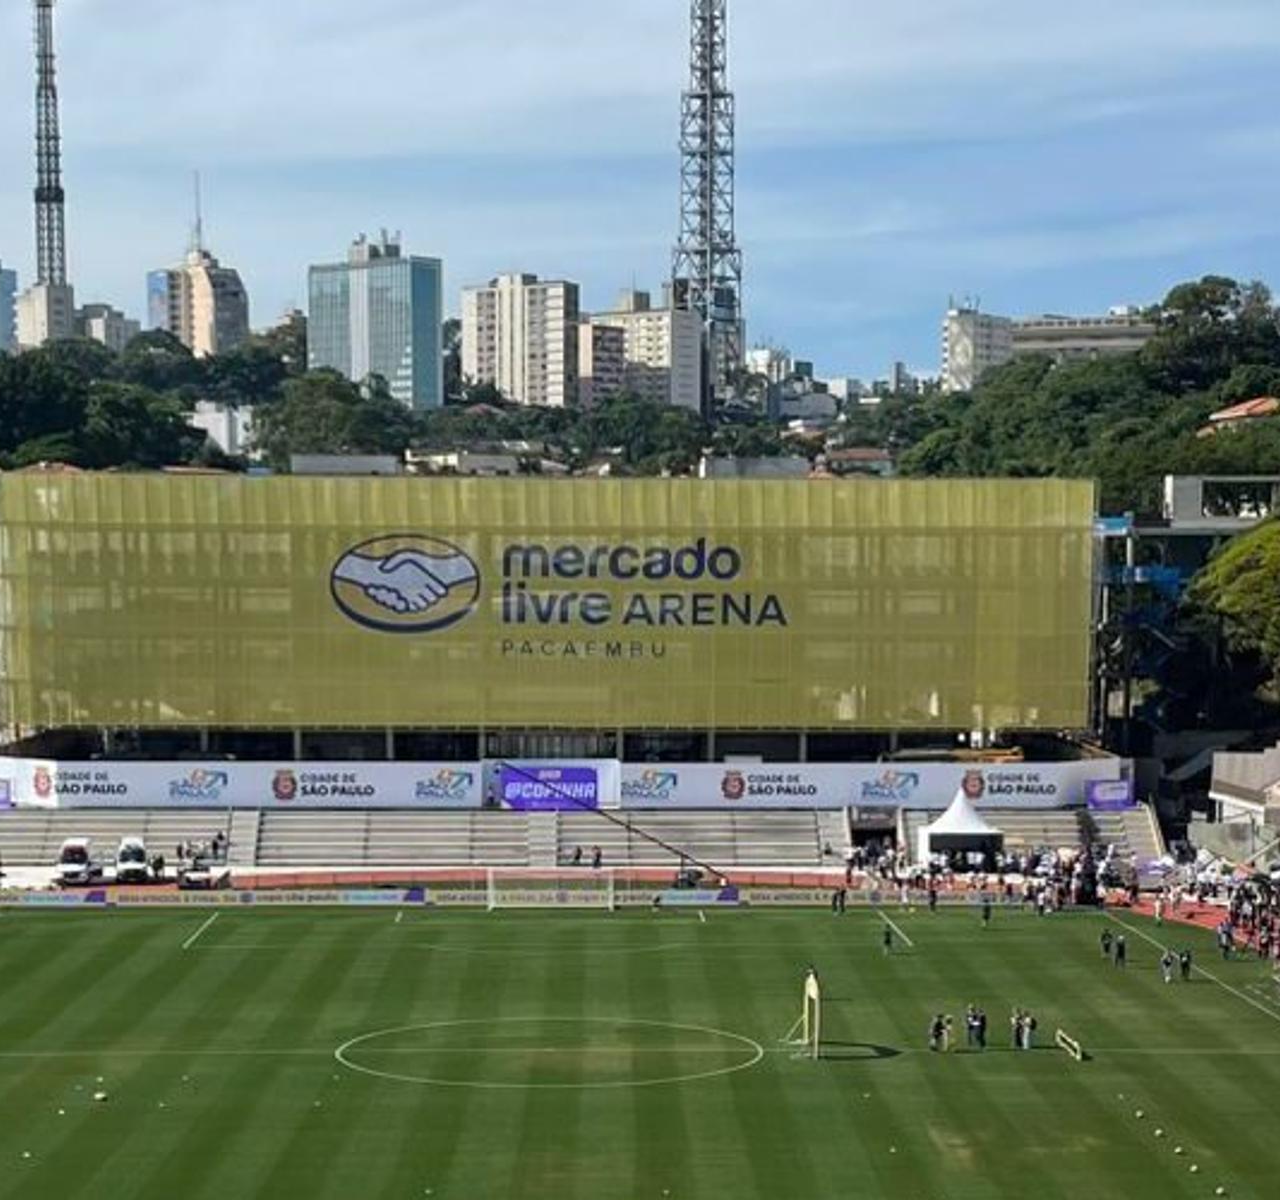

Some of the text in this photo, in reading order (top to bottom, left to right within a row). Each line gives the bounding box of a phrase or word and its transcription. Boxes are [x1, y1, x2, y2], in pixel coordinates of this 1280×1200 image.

[502, 538, 742, 580] mercado
[502, 582, 788, 626] livre ARENA
[502, 640, 666, 657] PACAEMBU
[82, 783, 127, 795] PAULO
[330, 784, 375, 797] PAULO
[776, 784, 817, 796] PAULO
[1016, 783, 1057, 796] PAULO
